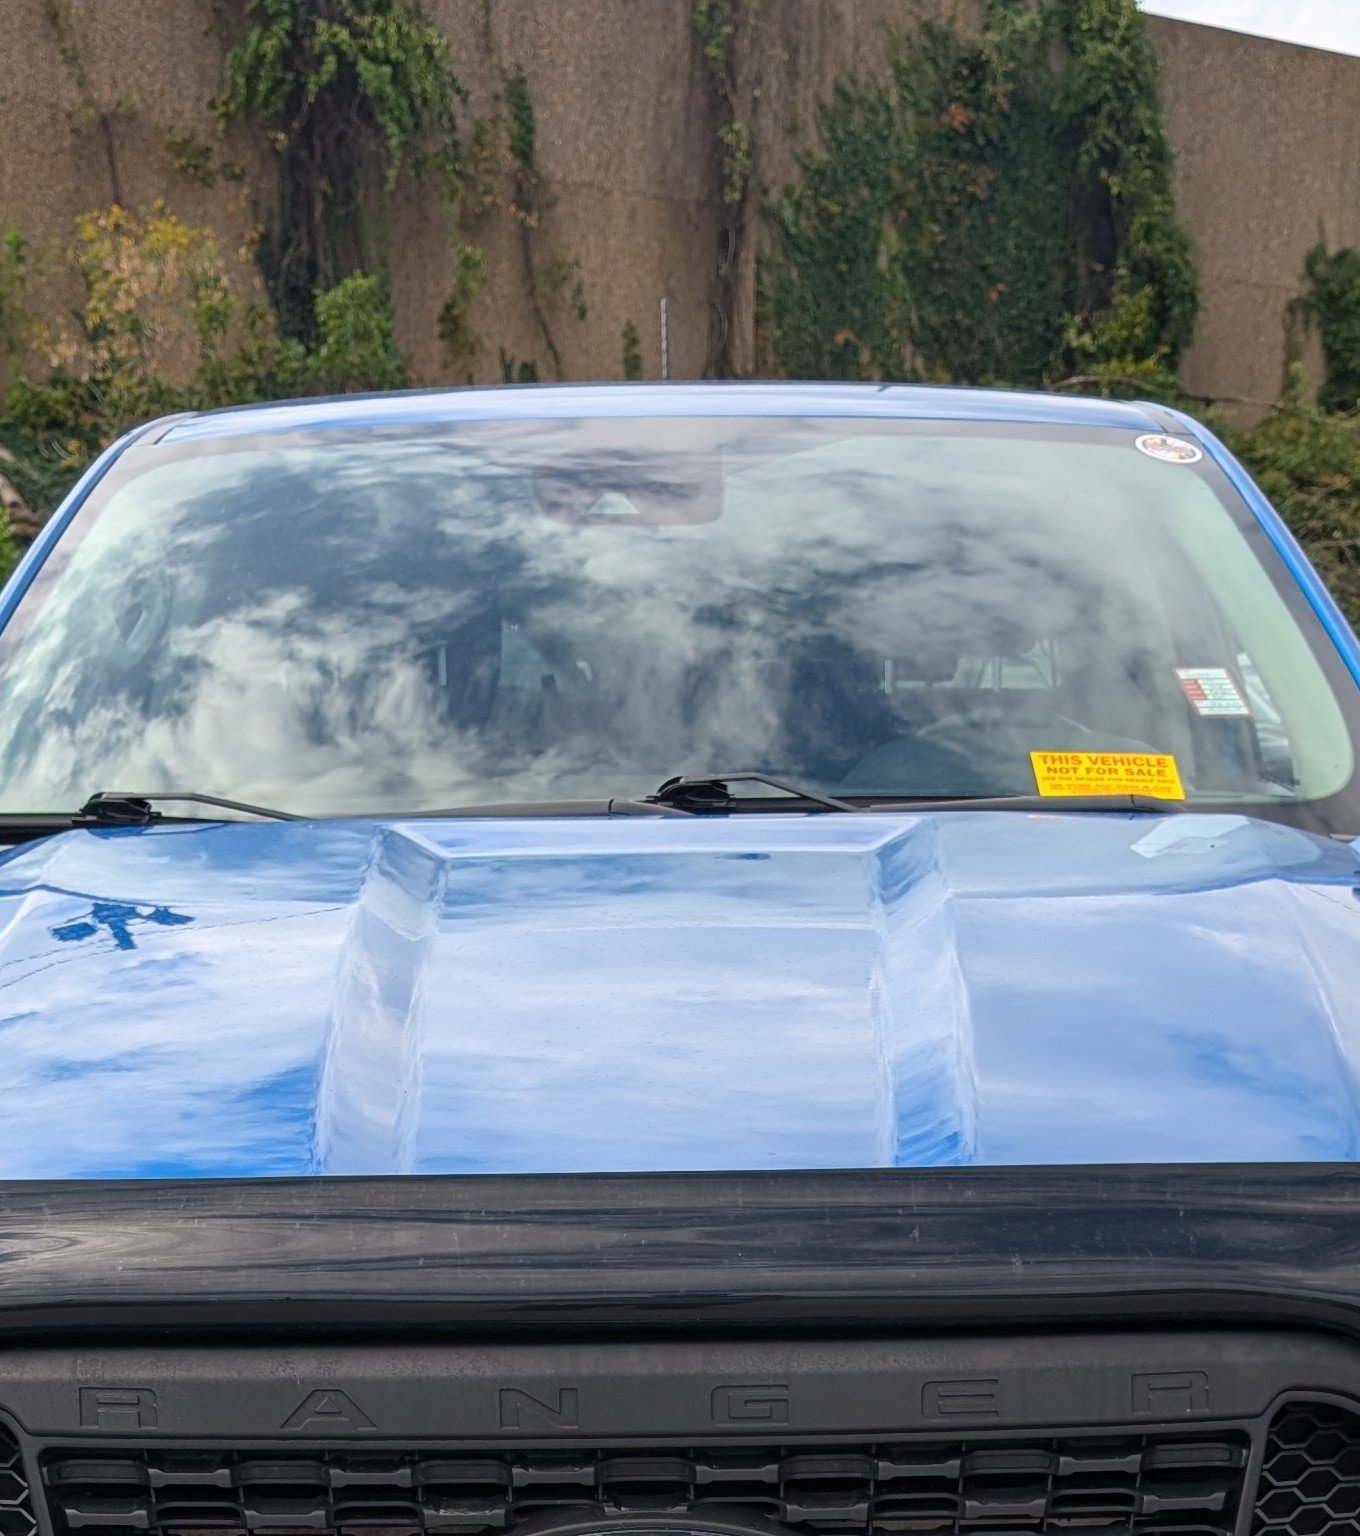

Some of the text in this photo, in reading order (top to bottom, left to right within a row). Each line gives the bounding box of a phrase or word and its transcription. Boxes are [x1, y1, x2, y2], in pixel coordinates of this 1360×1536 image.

[1039, 754, 1168, 768] THIS VEHICLE
[1046, 766, 1167, 777] NOT FOR SALE
[78, 1371, 1210, 1431] RANGER
